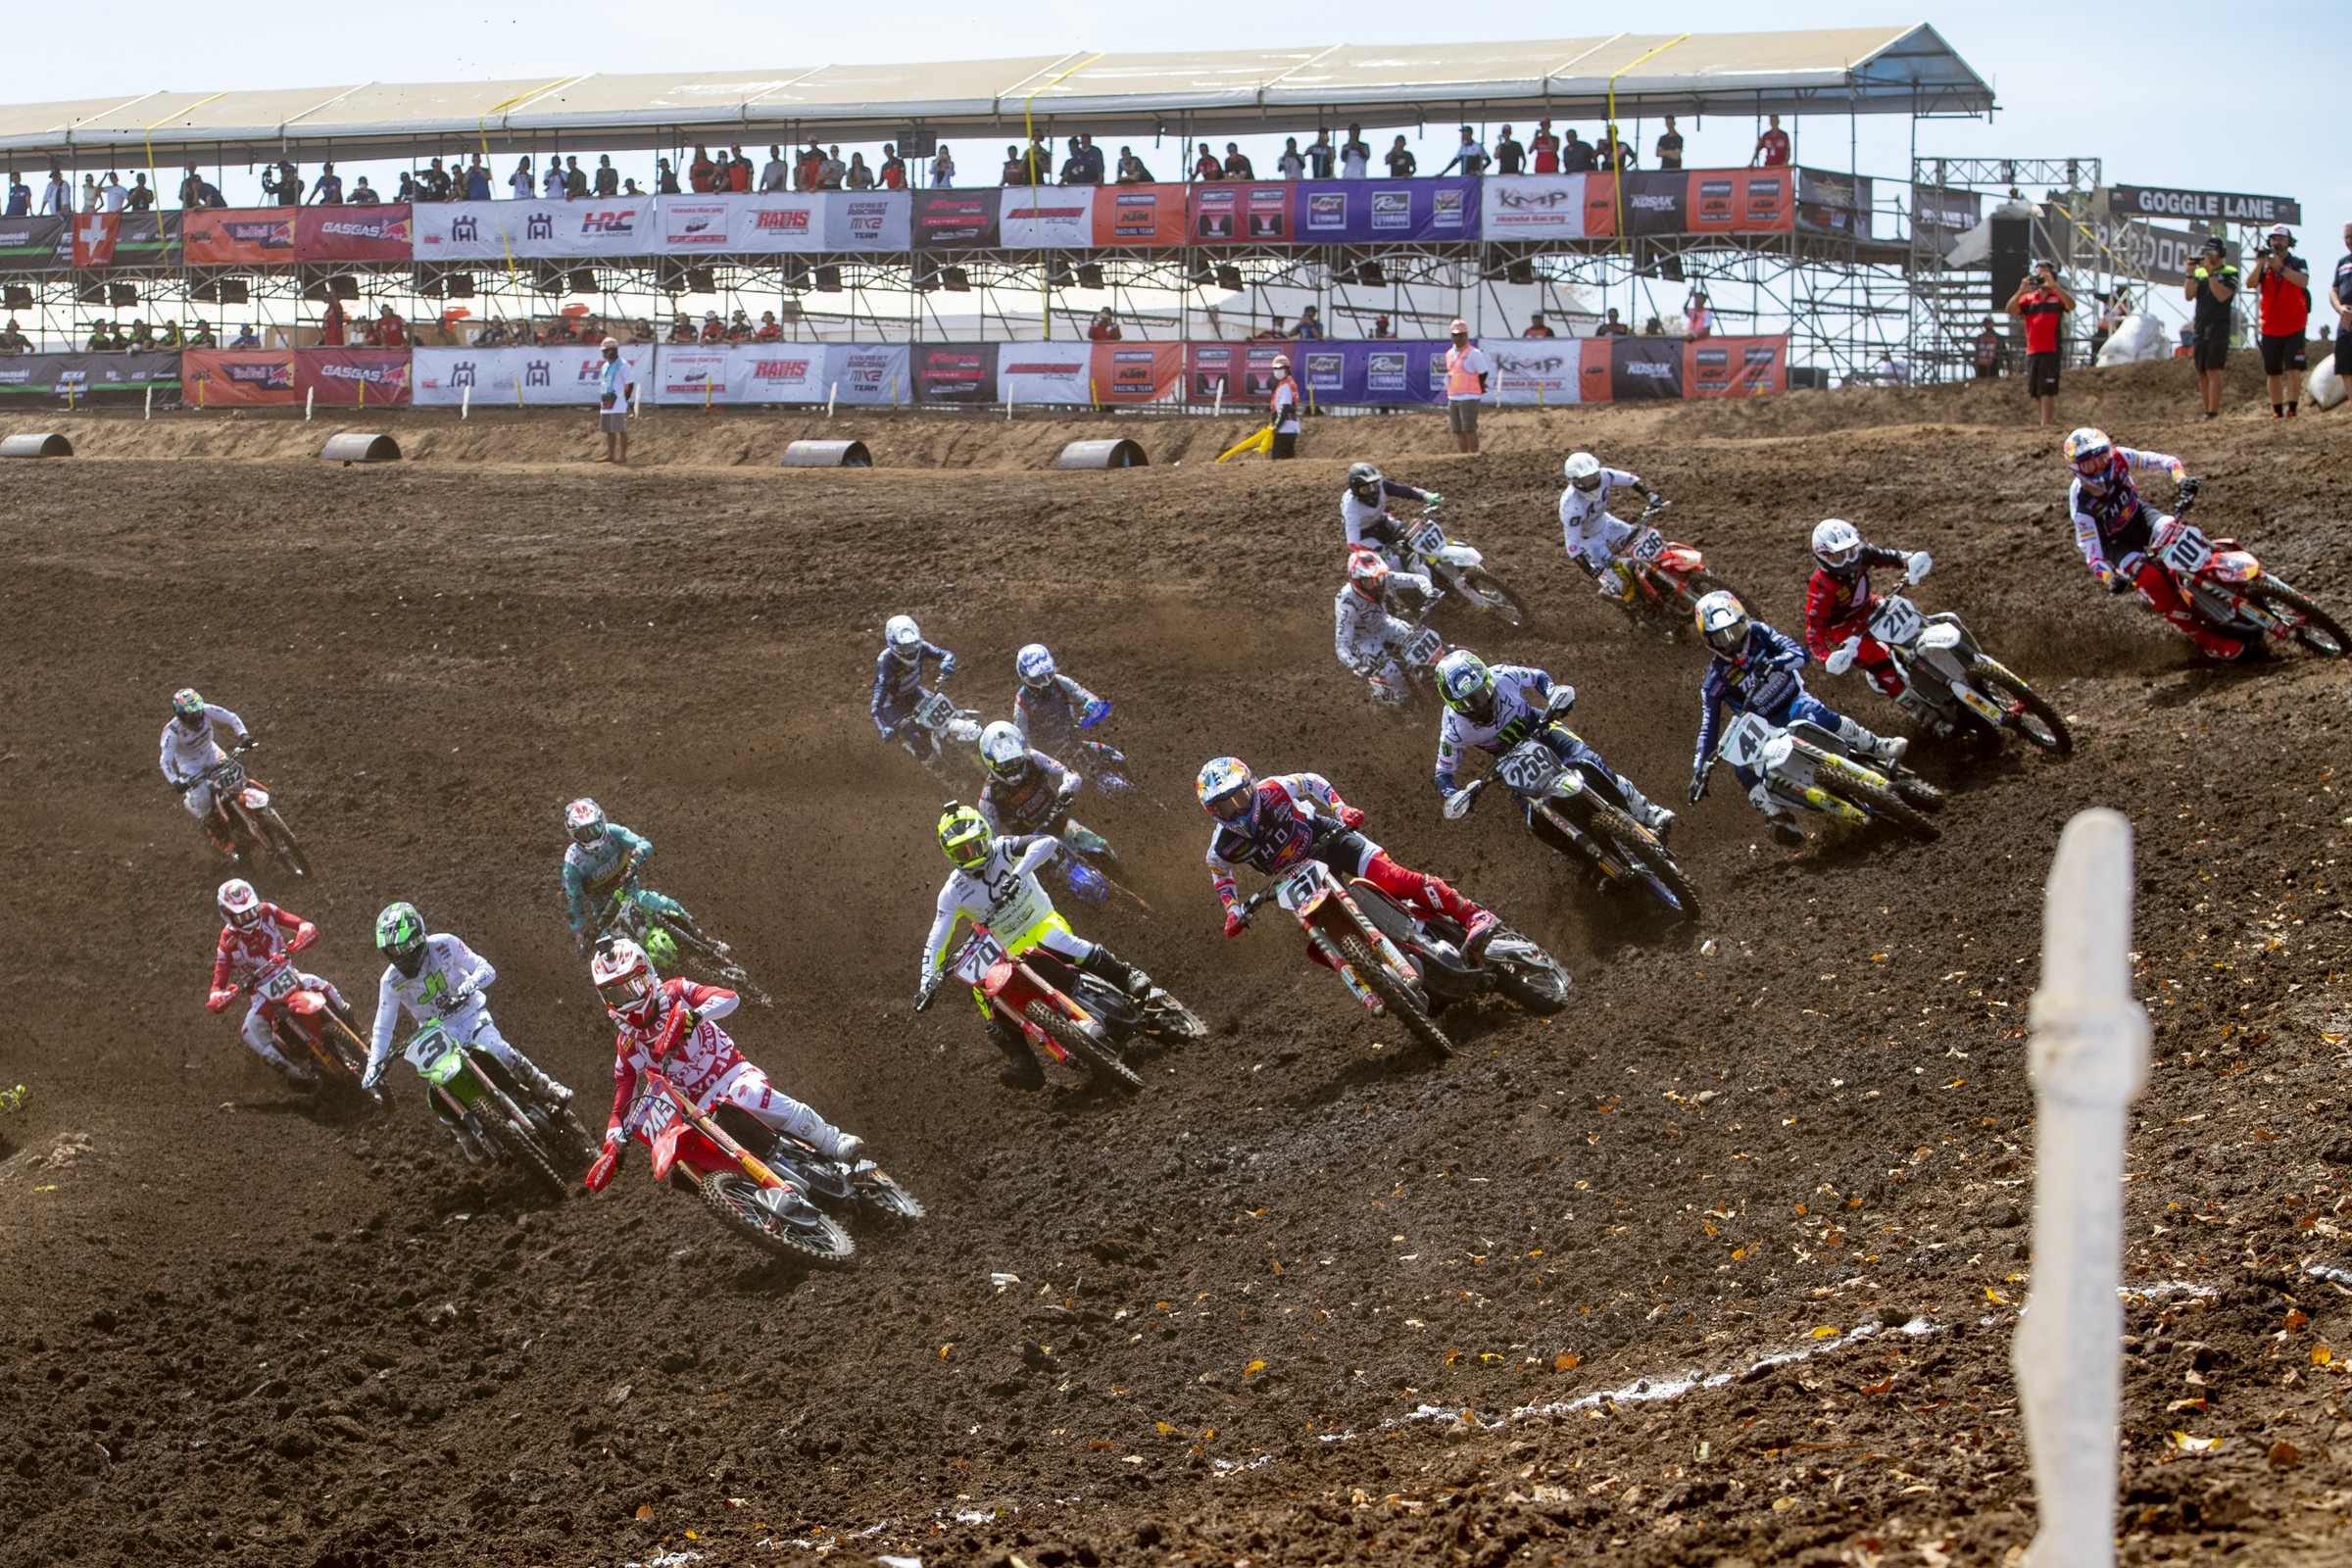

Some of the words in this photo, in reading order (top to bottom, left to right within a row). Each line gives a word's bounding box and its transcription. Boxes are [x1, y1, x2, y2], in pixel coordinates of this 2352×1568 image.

[1500, 189, 1567, 207] KMP
[1631, 195, 1675, 208] KOSAK
[2138, 190, 2219, 217] GOGGLE
[2224, 196, 2275, 220] LANE
[581, 210, 636, 232] HRC
[757, 211, 810, 228] RATHS
[850, 217, 883, 229] MX2
[1120, 211, 1149, 221] KTM
[1531, 215, 1566, 223] Racing
[321, 221, 381, 238] GASGAS
[321, 364, 381, 381] GASGAS
[755, 361, 809, 377] RATHS
[1496, 355, 1563, 372] KMP
[1626, 363, 1672, 375] KOSAK
[850, 370, 883, 381] MX2
[1421, 529, 1446, 550] 167
[1636, 531, 1663, 560] 336
[2171, 530, 2203, 568] 101
[1883, 602, 1913, 640] 211
[1739, 719, 1766, 762] 41
[215, 764, 243, 790] 162
[1510, 746, 1551, 788] 259
[1287, 865, 1322, 909] 61
[966, 941, 1002, 981] 70
[269, 968, 297, 998] 43
[417, 1031, 447, 1070] 3
[640, 1090, 678, 1147] 243
[594, 1154, 613, 1187] ACERBIS
